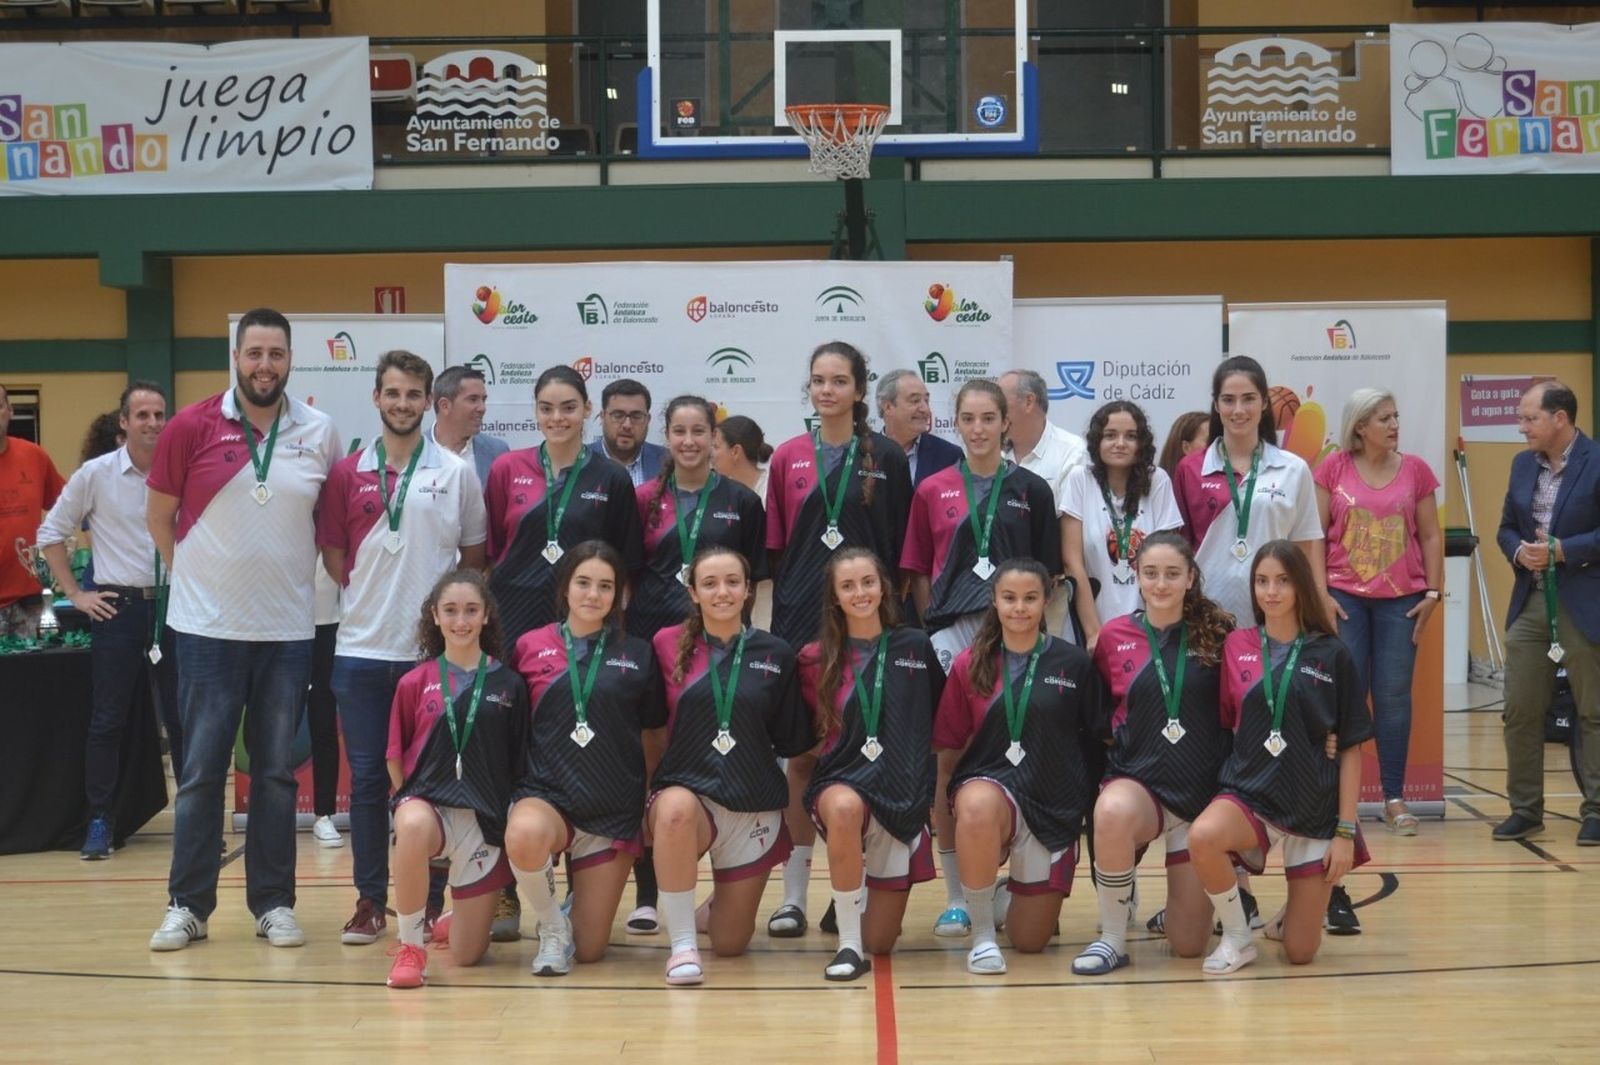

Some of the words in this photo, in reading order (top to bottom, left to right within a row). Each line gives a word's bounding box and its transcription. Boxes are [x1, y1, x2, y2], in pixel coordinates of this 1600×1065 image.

[144, 65, 308, 125] juega
[1505, 73, 1595, 116] San
[0, 98, 82, 141] San
[405, 115, 533, 134] Ayuntamiento
[538, 114, 561, 129] de
[1201, 106, 1330, 127] Ayuntamiento
[1334, 106, 1357, 122] de
[180, 109, 356, 176] limpio
[406, 133, 447, 152] San
[454, 131, 560, 151] Fernando
[1202, 125, 1243, 144] San
[1250, 124, 1357, 144] Fernando
[503, 311, 538, 324] cesto
[956, 309, 992, 323] cesto
[1103, 359, 1191, 380] Diputación
[1103, 383, 1123, 400] de
[1130, 383, 1175, 400] Cádiz
